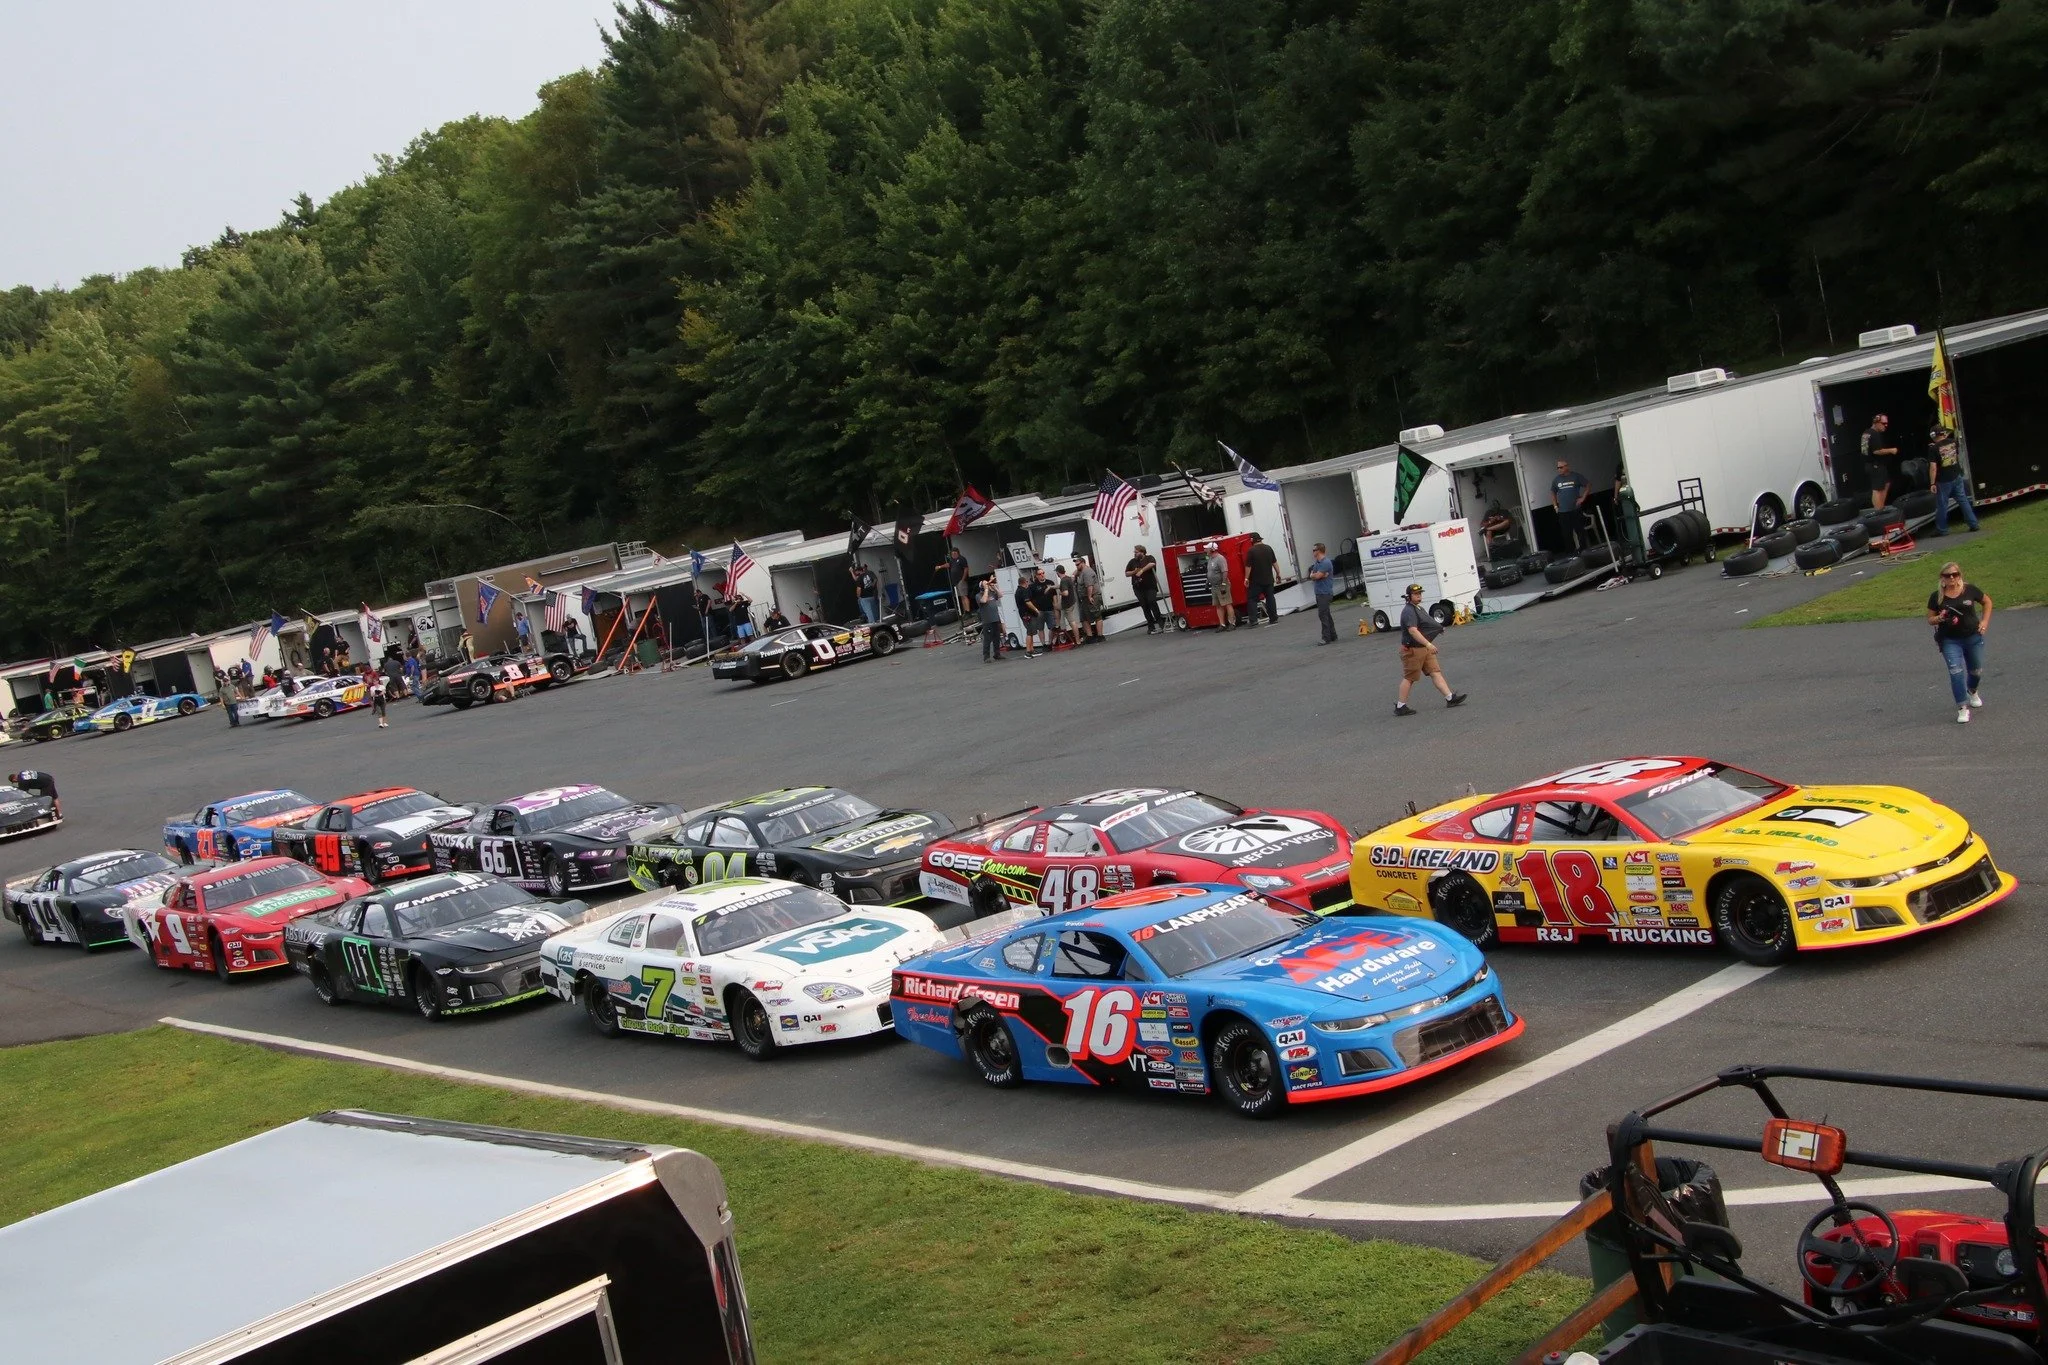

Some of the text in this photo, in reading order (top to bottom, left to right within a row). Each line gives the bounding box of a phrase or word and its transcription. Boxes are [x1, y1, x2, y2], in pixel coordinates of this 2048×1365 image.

[760, 648, 783, 658] Premier
[1648, 767, 1715, 798] FISHER
[232, 791, 294, 810] PEMBROKE
[430, 834, 475, 850] BOOSKA
[843, 821, 917, 849] CHEVROLET
[480, 840, 507, 874] 66
[1232, 845, 1283, 867] NEFCU
[1286, 829, 1335, 846] VSECU
[1624, 851, 1650, 862] ACT
[929, 851, 984, 871] GOSS
[1371, 847, 1499, 873] S.D. IRELAND
[215, 876, 242, 887] BANK
[1376, 870, 1418, 880] CONCRETE
[410, 881, 490, 907] MARTIN
[1037, 864, 1100, 915] 48
[1514, 850, 1620, 926] 18
[716, 888, 793, 916] BOUCHARD
[1718, 888, 1736, 932] Hoosier
[1824, 895, 1850, 907] QA1
[1153, 894, 1254, 933] LANPHEAR
[165, 913, 192, 955] 9
[285, 928, 326, 946] ABSOLUTE
[778, 923, 891, 954] VSAC
[1131, 926, 1155, 943] 16
[1537, 928, 1713, 943] R&J TRUCKING
[559, 947, 573, 963] kas
[603, 954, 625, 964] science
[583, 961, 606, 970] services
[1316, 940, 1437, 992] Hardware
[1391, 969, 1421, 985] Vermont
[642, 965, 677, 1021] 7
[904, 976, 1020, 1009] Richard Green
[1141, 991, 1166, 1007] ACT
[803, 1014, 822, 1022] QA1
[907, 1006, 950, 1028] Trucking
[1064, 986, 1141, 1066] 16
[669, 1023, 690, 1038] Shop
[1216, 1028, 1249, 1052] Hoosier
[1278, 1031, 1303, 1044] QA1
[1128, 1054, 1148, 1072] VT
[1291, 1068, 1317, 1079] SUNOCO
[1240, 1090, 1273, 1112] Hoosier
